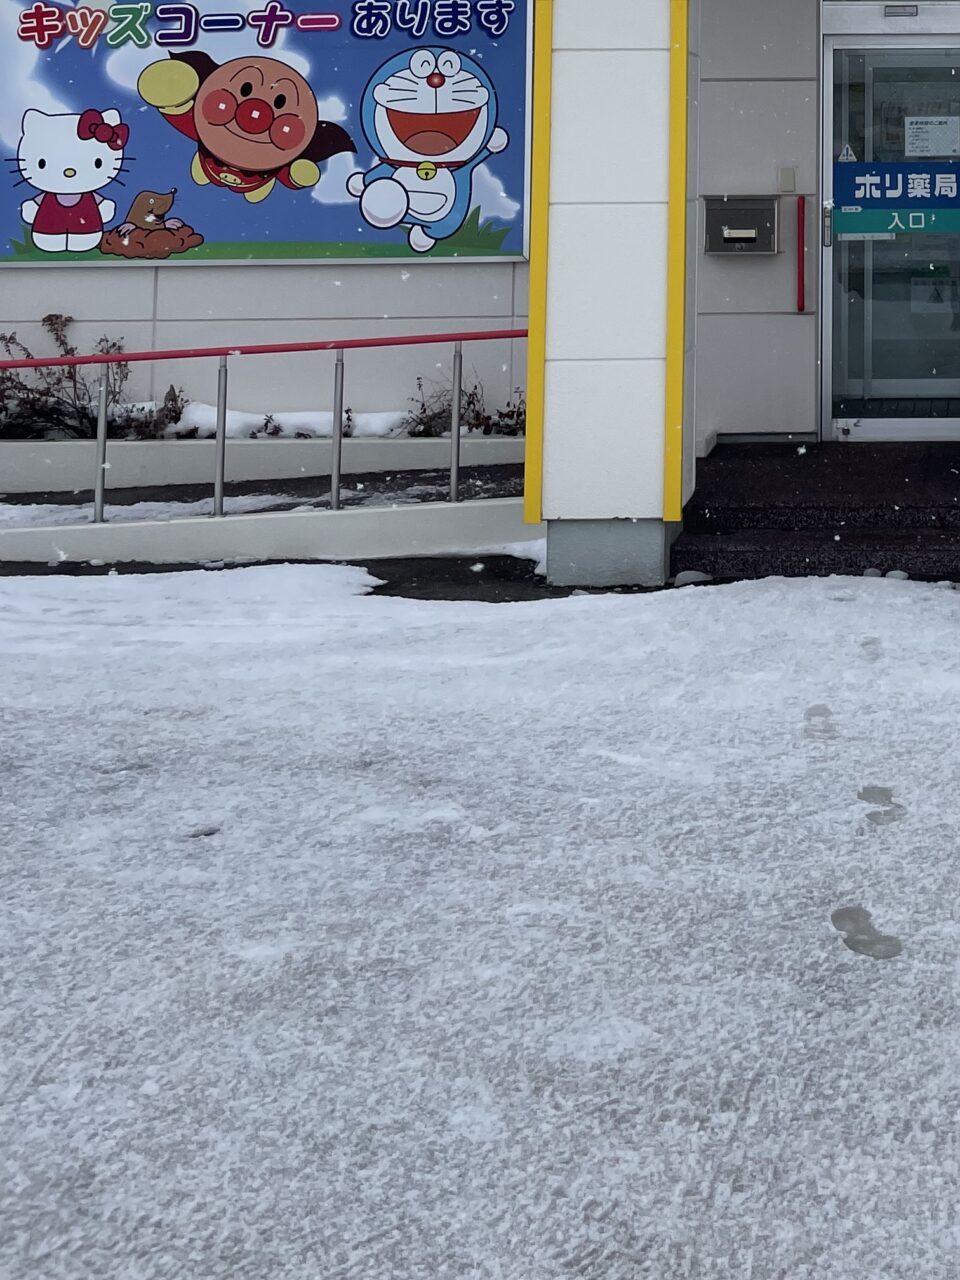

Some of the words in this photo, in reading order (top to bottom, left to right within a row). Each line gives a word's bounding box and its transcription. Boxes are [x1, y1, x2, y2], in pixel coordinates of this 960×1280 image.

[18, 0, 342, 49] キッズコーナー
[855, 173, 958, 198] ホリ薬局
[888, 213, 925, 230] 入口
